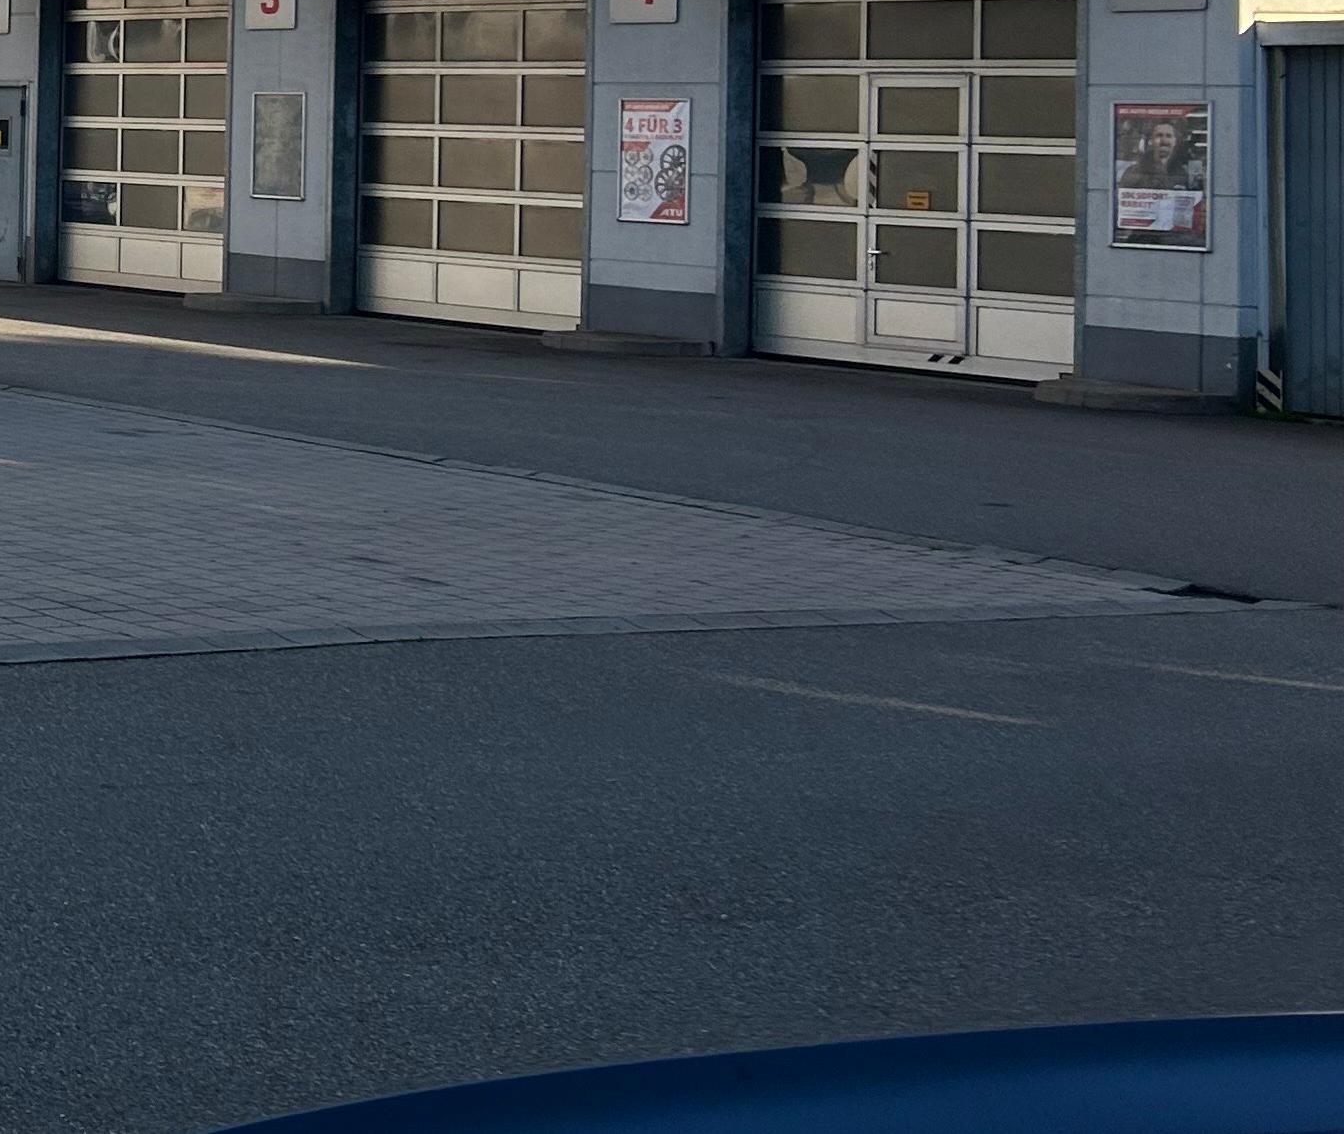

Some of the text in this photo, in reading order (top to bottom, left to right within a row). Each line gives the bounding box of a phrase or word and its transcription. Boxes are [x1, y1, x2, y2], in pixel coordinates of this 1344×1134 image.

[625, 115, 682, 134] 4 FÜR 3
